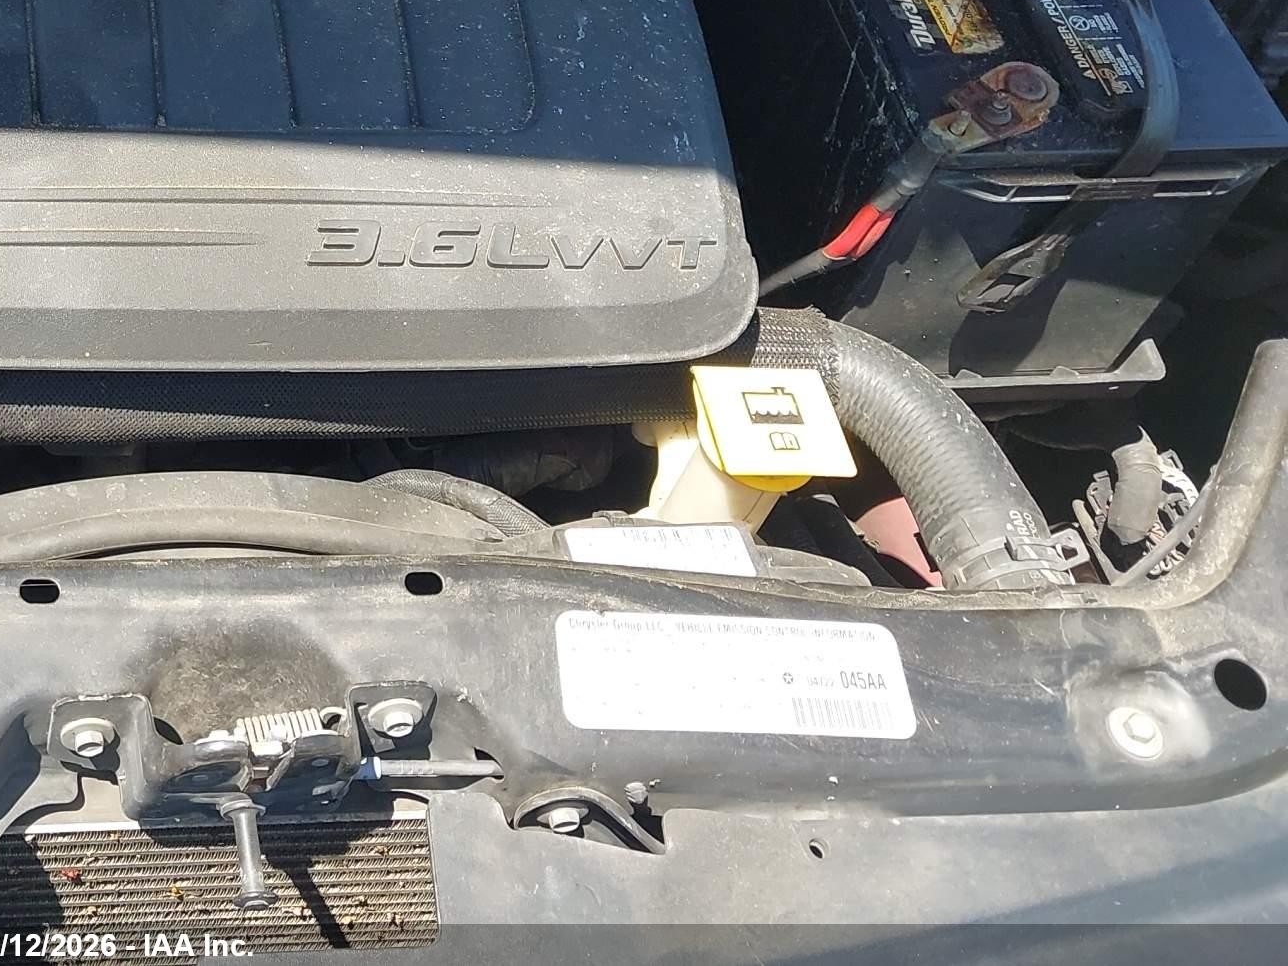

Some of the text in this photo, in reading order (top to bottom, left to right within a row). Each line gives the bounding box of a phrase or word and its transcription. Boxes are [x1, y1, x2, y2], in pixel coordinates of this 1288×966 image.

[1057, 26, 1090, 67] DANGER
[306, 219, 718, 270] 3.6L VVT
[1009, 510, 1030, 536] RAD
[840, 671, 888, 690] 045AA
